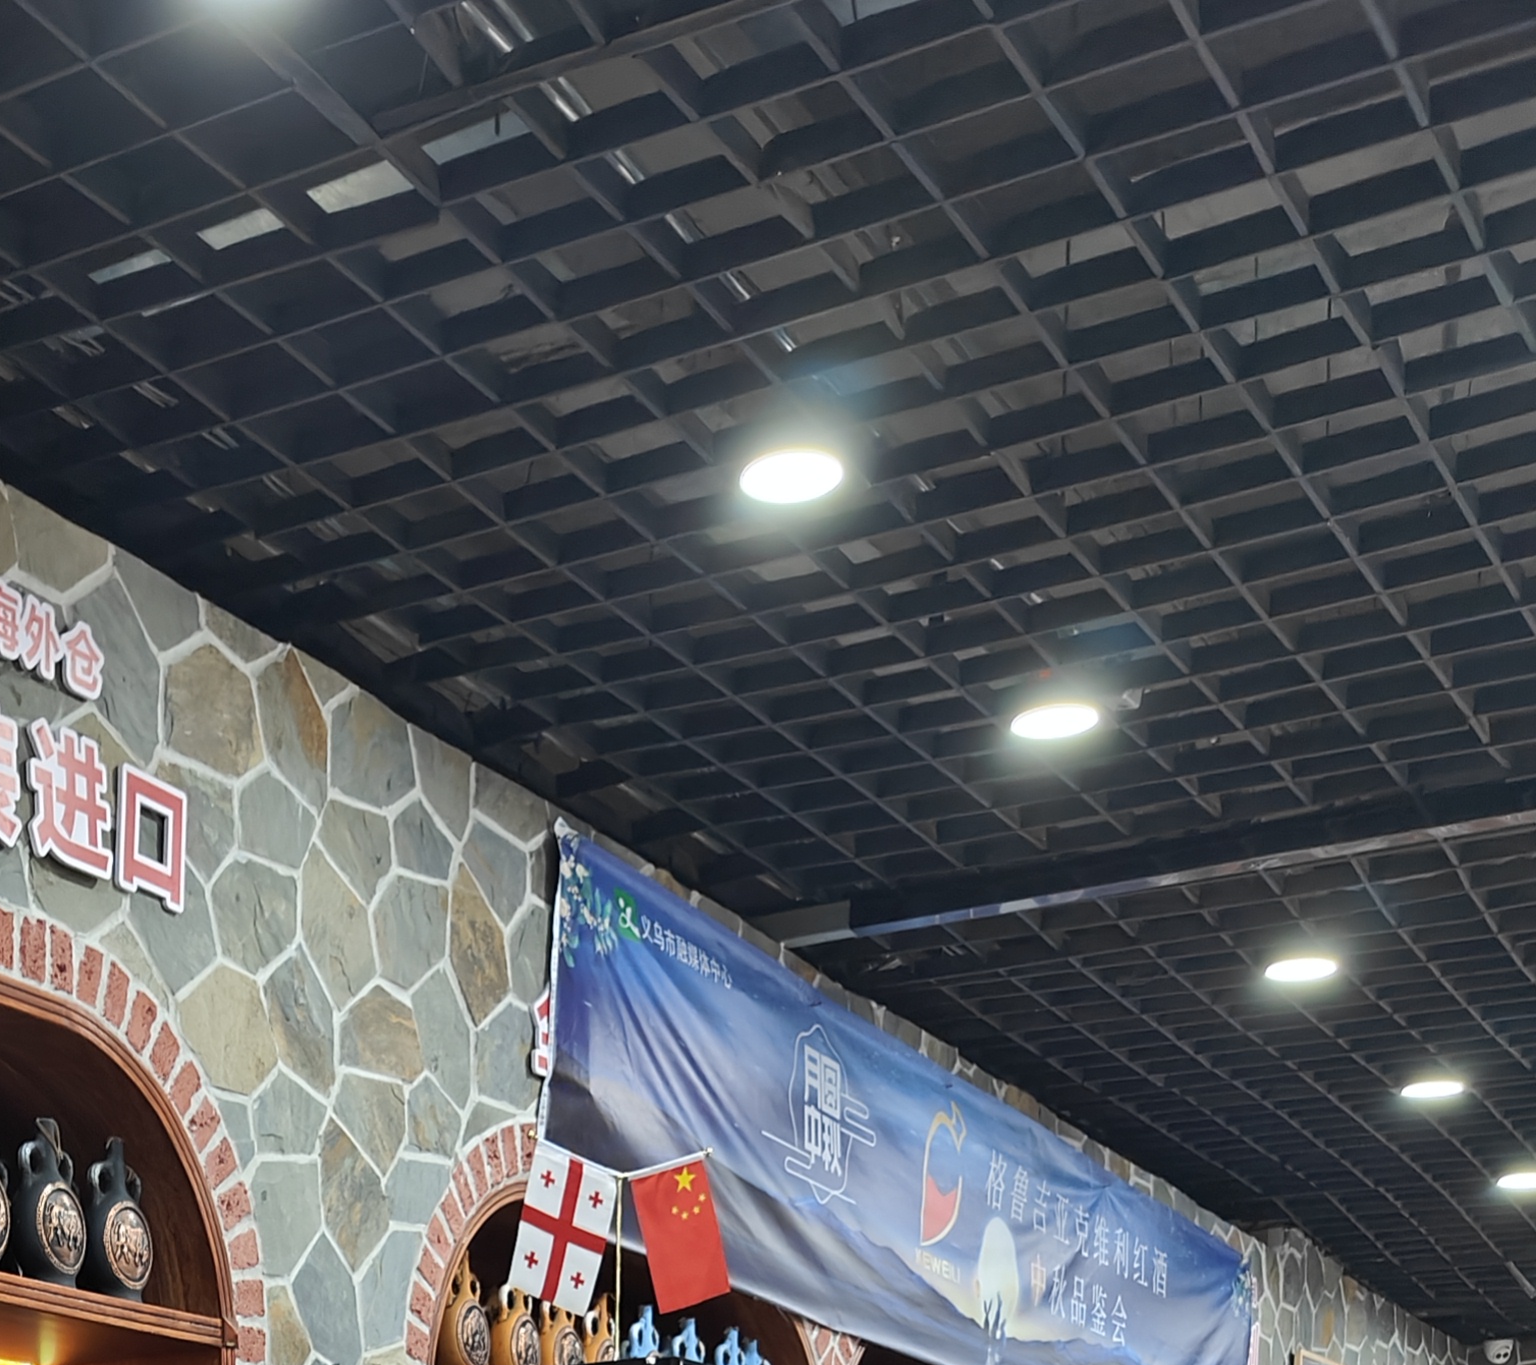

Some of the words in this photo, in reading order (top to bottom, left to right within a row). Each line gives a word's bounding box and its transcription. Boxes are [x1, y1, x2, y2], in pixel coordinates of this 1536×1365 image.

[641, 915, 734, 990] 义乌市融媒体中心
[985, 1148, 1169, 1299] 格鲁吉亚克维利红酒
[1029, 1253, 1129, 1348] 中秋品鉴会
